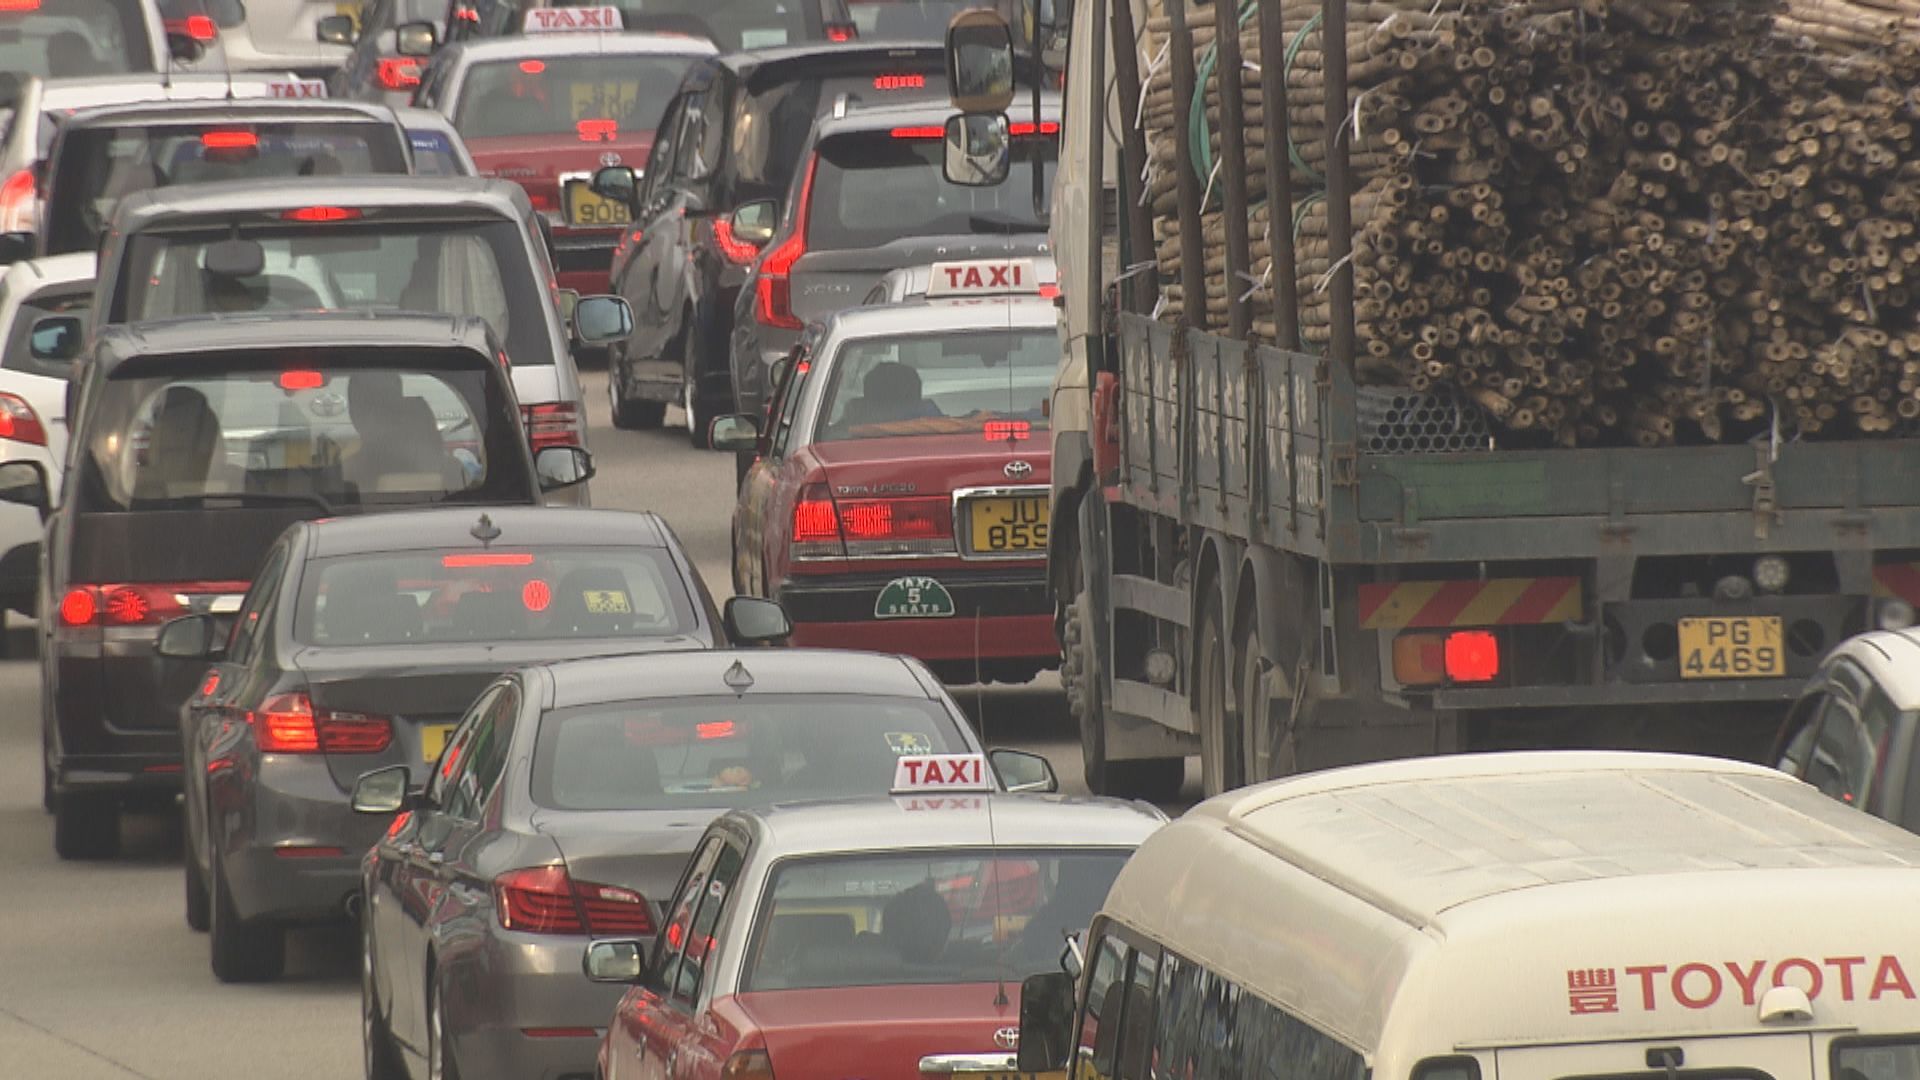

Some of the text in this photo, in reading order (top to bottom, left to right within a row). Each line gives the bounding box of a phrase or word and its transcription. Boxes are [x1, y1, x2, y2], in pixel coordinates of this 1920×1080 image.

[535, 11, 614, 27] TAXI
[271, 83, 321, 98] TAXI
[944, 265, 1021, 288] TAXI
[1001, 499, 1039, 524] JU
[895, 577, 933, 590] TAXI
[908, 588, 921, 604] 5
[889, 603, 940, 614] SEATS
[1707, 620, 1752, 645] PG
[1685, 647, 1776, 673] 4469
[904, 760, 980, 785] TAXI
[1625, 955, 1917, 1012] TOYOTA
